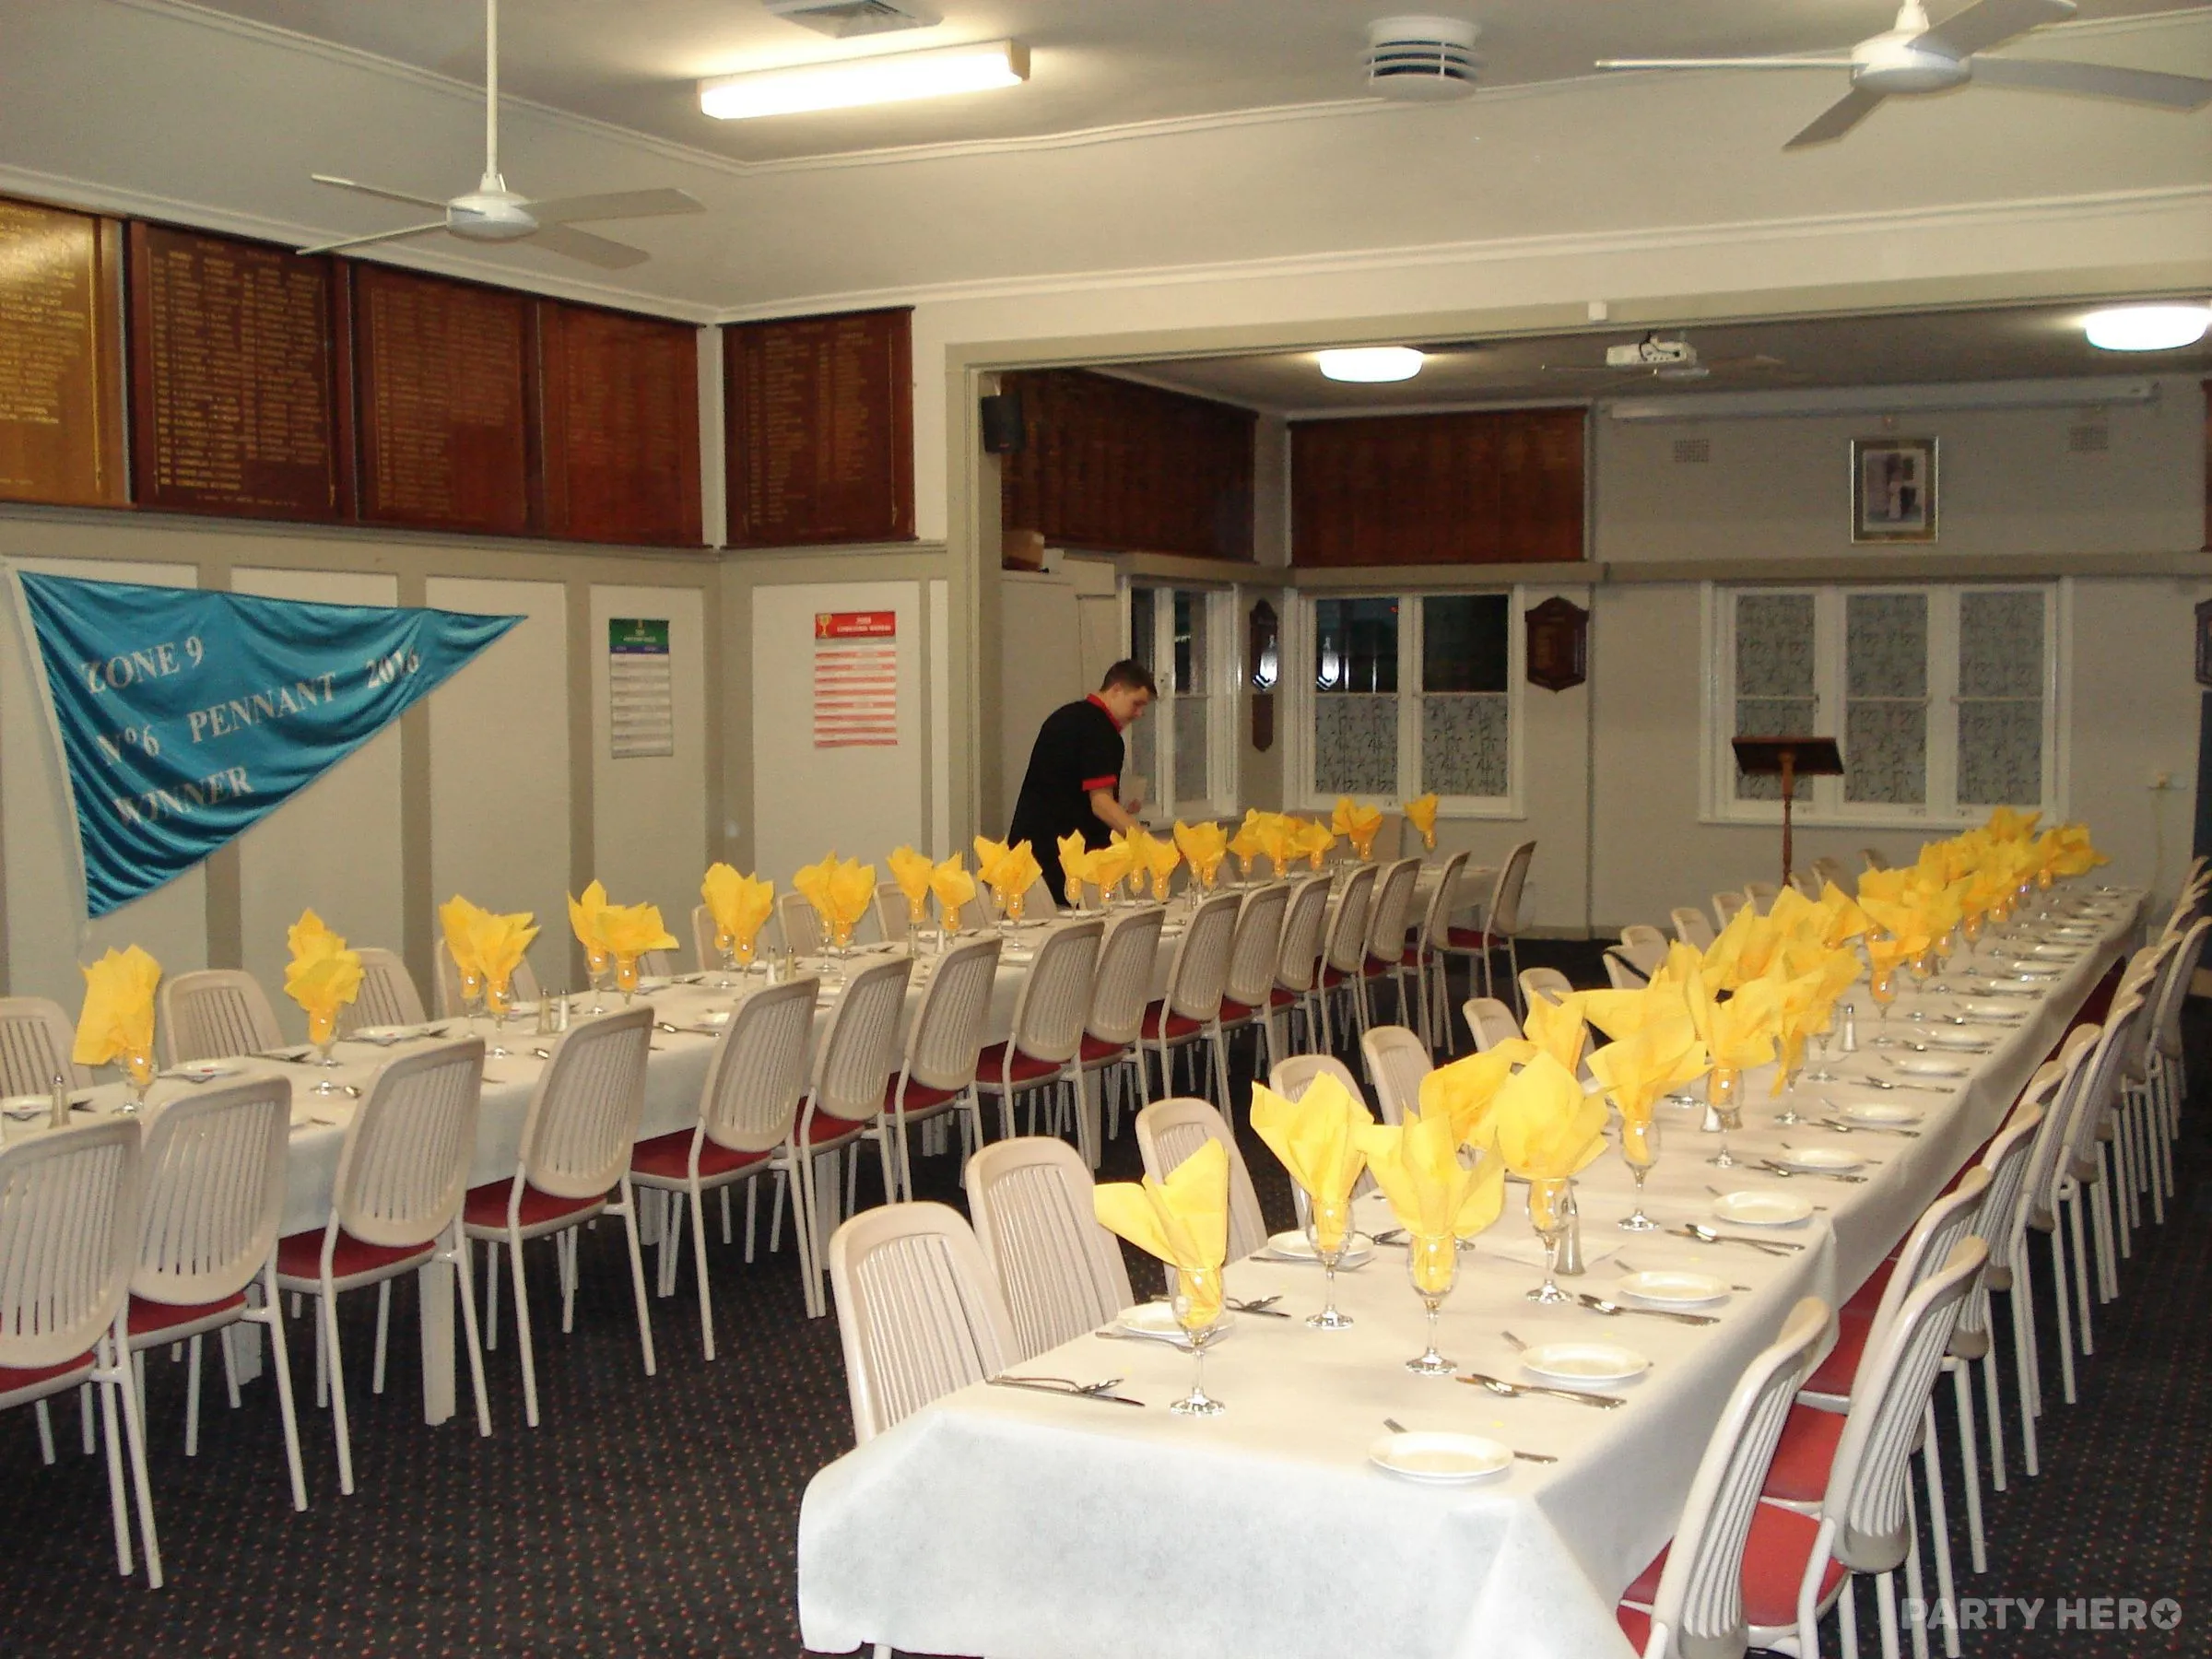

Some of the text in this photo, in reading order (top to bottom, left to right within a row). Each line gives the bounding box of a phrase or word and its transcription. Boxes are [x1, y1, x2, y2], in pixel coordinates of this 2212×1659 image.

[80, 635, 205, 693] ZONE 9
[187, 670, 335, 744] PENNANT
